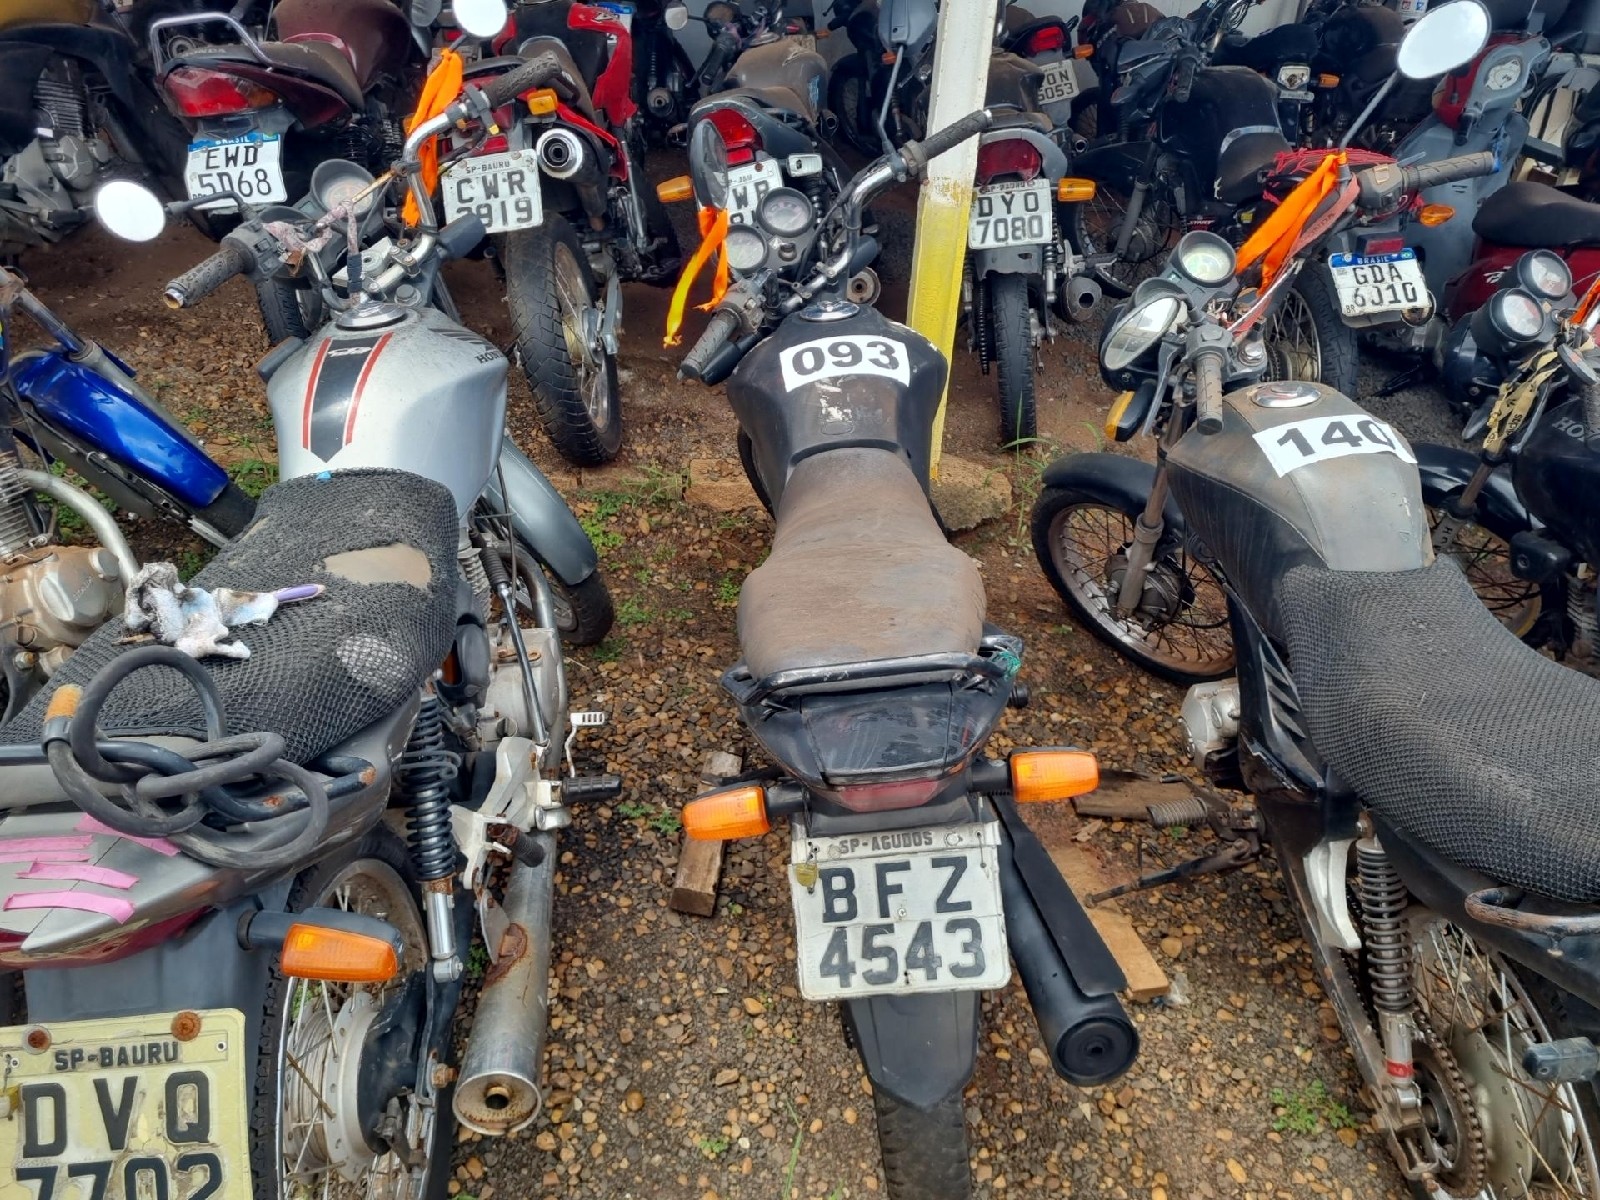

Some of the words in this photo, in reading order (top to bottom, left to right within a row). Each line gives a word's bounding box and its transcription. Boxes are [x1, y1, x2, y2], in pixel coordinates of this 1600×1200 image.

[1046, 69, 1069, 85] ON
[206, 146, 258, 169] EWD
[466, 160, 510, 174] SP-BAURU
[198, 169, 272, 197] 5D68
[457, 170, 526, 203] CWR
[977, 192, 1039, 217] DYO
[976, 215, 1043, 244] 7080
[1352, 263, 1402, 285] GDA
[1356, 256, 1390, 264] BRASIL
[1354, 282, 1417, 307] 6J10
[792, 341, 899, 375] 093
[1277, 420, 1396, 457] 140
[839, 831, 933, 853] SP-AGUDOS
[818, 856, 972, 923] BFZ
[819, 918, 986, 988] 4543
[55, 1041, 179, 1071] SP-BAURU
[22, 1070, 210, 1158] DVQ
